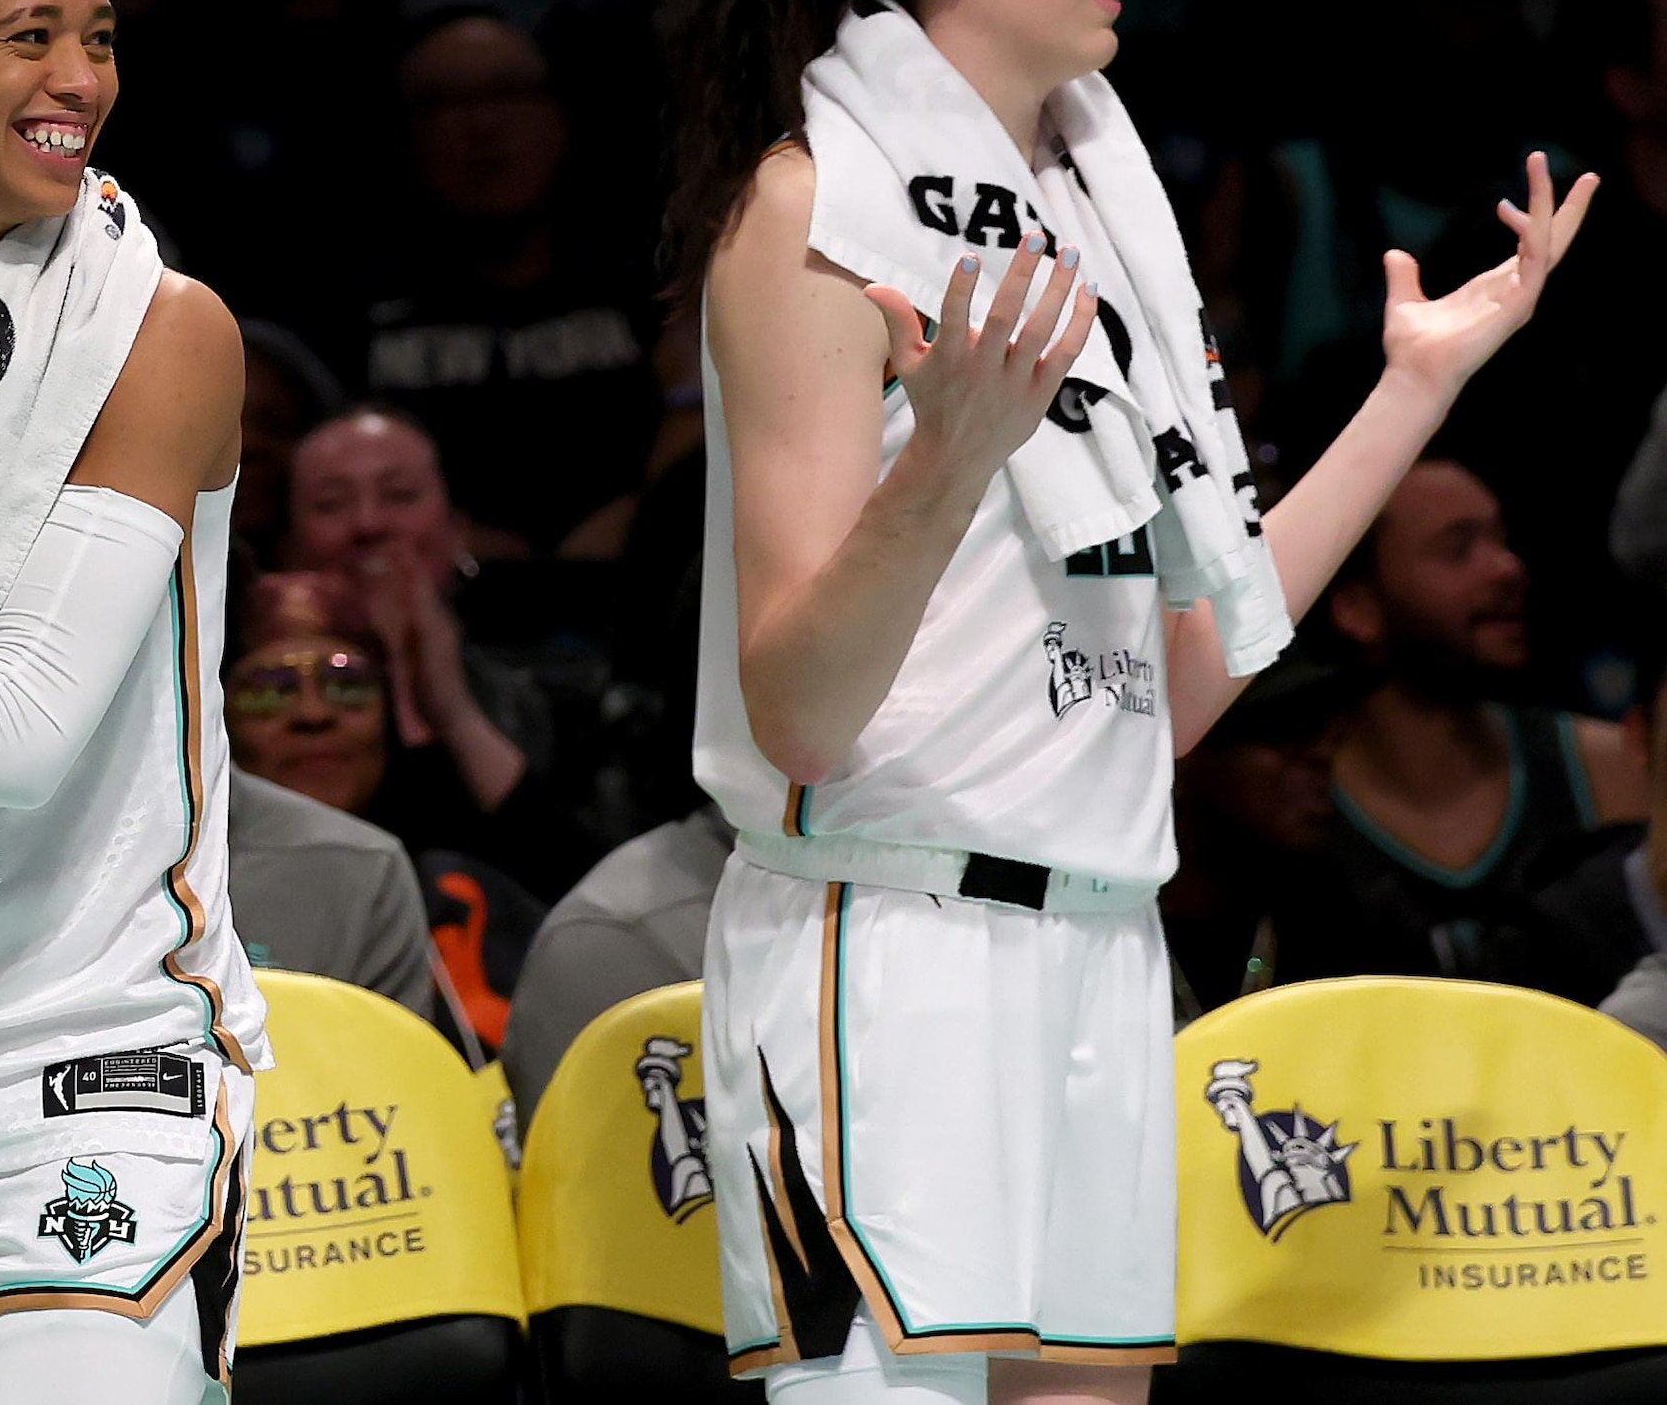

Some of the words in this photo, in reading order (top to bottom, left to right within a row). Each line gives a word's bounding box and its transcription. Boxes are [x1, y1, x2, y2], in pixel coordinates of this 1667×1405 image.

[82, 1071, 97, 1082] 40
[252, 1101, 399, 1166] erty
[1378, 1118, 1627, 1188] Liberty
[247, 1149, 415, 1223] utual
[1383, 1176, 1646, 1238] Mutual
[244, 1227, 426, 1276] SURANCE
[1418, 1254, 1648, 1290] INSURANCE
